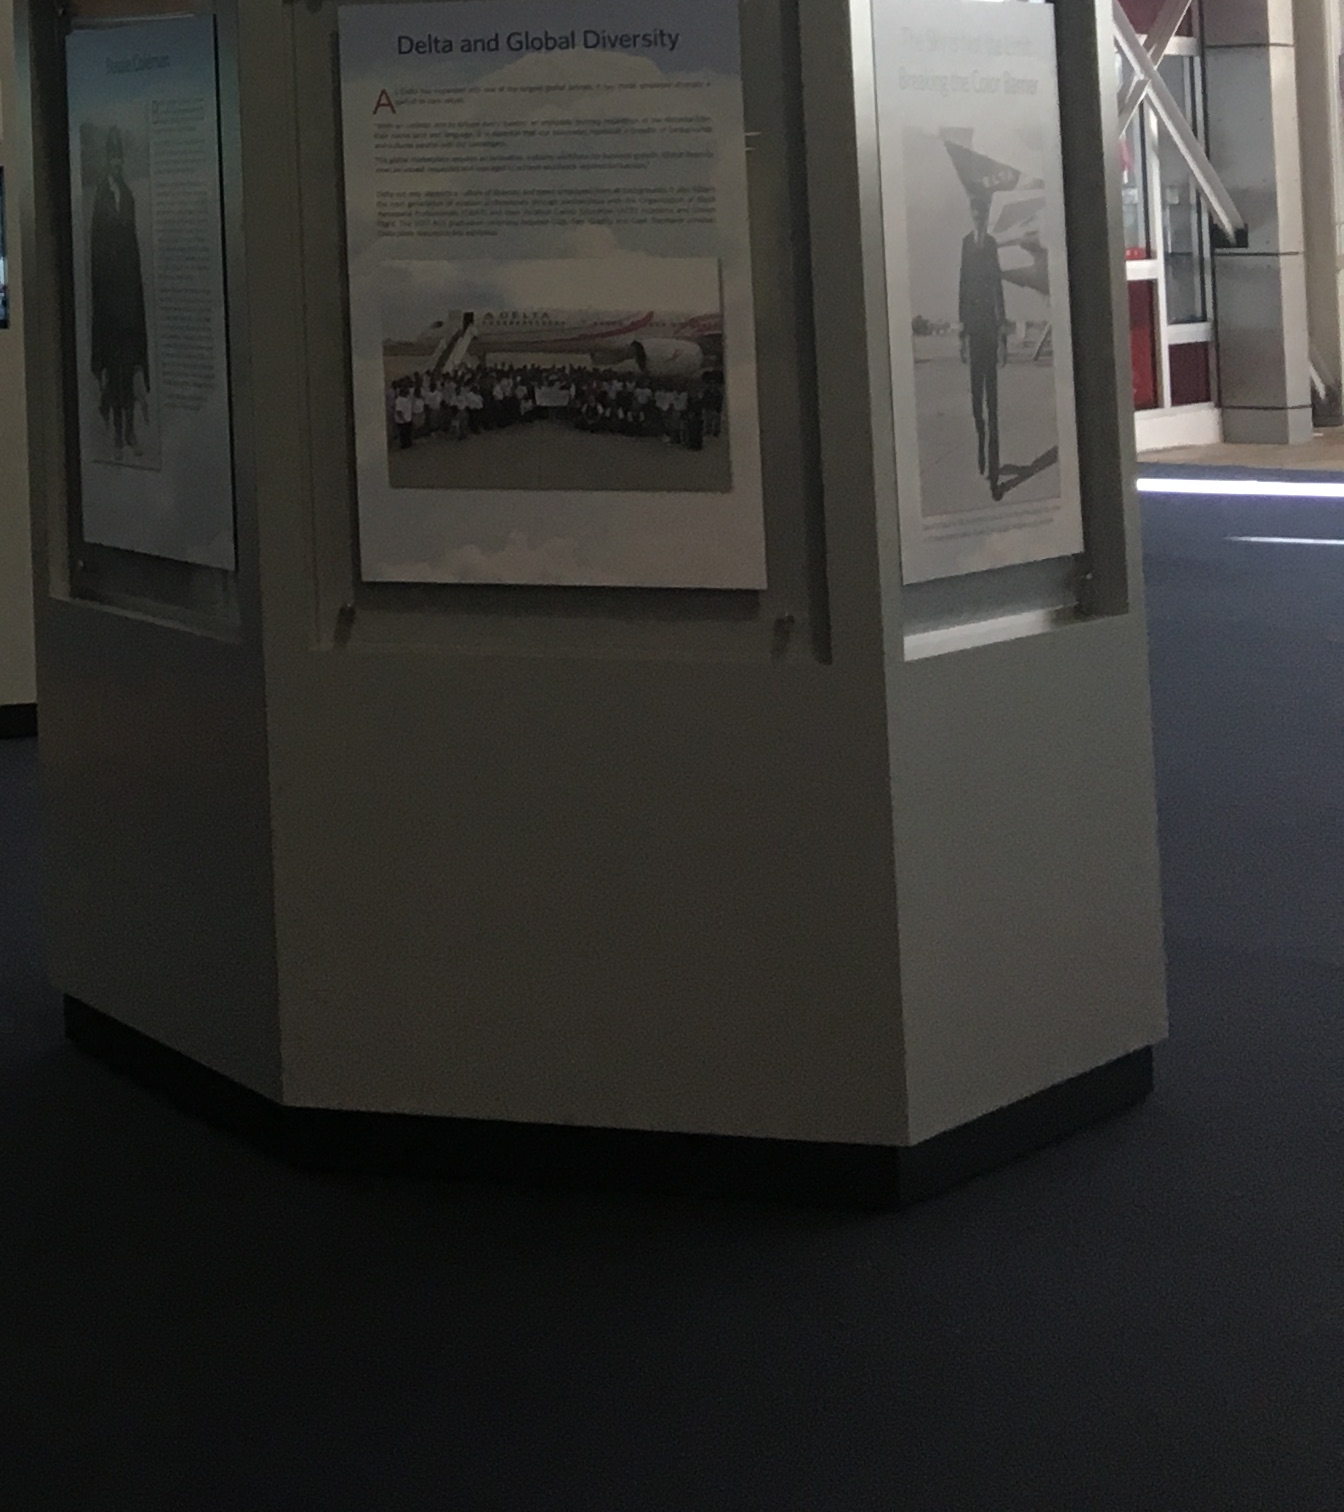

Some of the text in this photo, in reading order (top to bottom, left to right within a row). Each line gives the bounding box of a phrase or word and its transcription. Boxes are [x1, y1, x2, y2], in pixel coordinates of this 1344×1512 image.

[397, 28, 680, 55] Delta and Global Diversity
